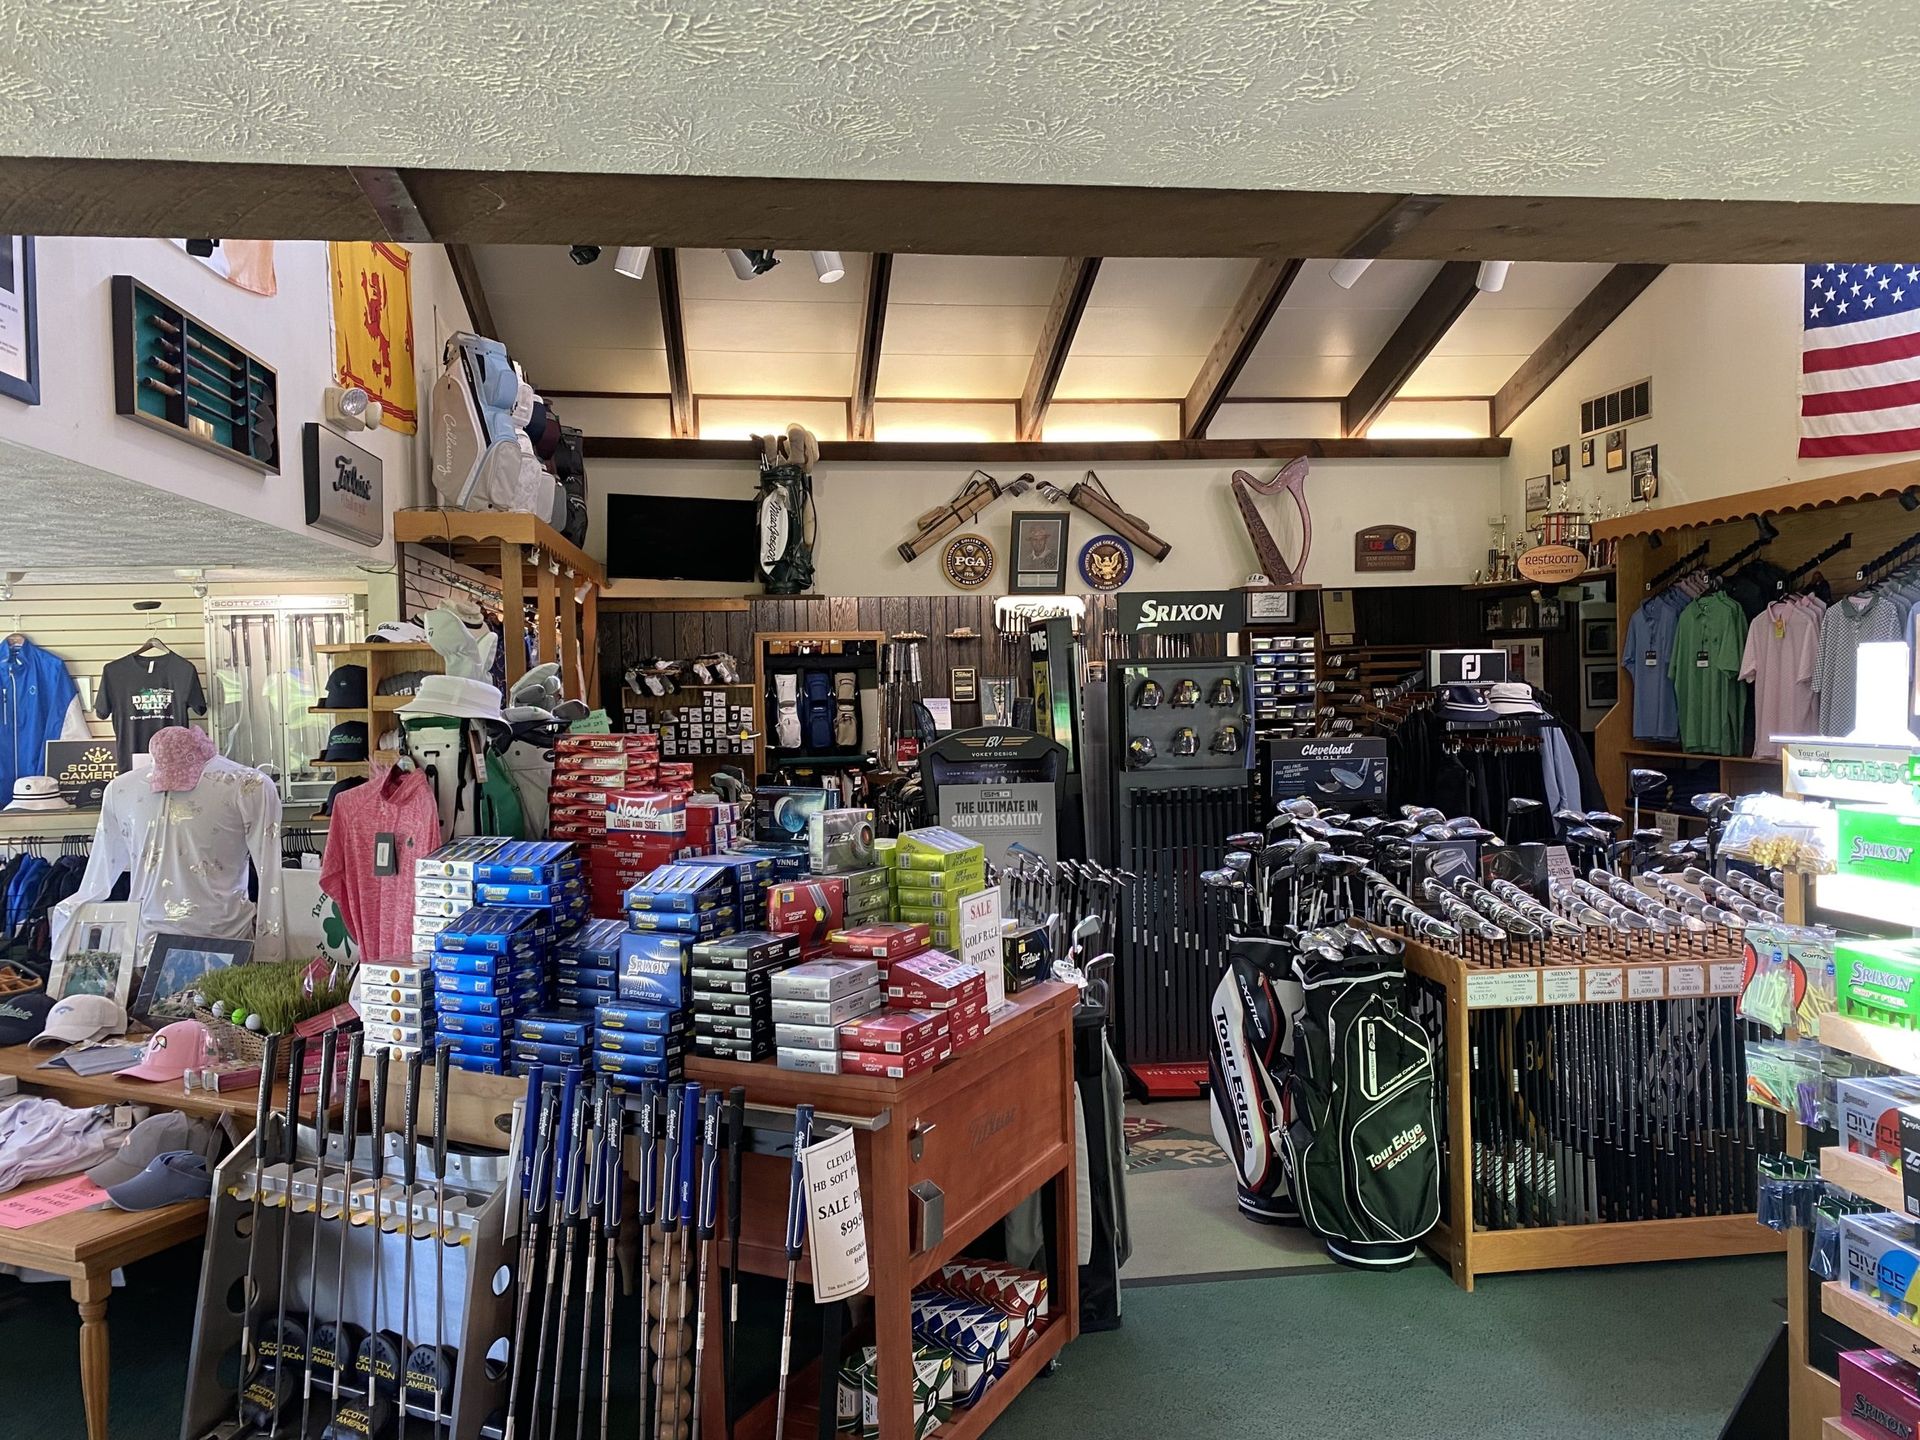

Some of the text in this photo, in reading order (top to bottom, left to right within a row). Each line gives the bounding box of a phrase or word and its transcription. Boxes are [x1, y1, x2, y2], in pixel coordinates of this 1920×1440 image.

[766, 500, 782, 561] MacGregor
[954, 556, 986, 567] PGA
[962, 576, 984, 585] AMERICA
[214, 600, 250, 608] SCOTTY
[1137, 599, 1224, 627] SRIXON
[1461, 654, 1481, 680] FJ
[131, 695, 172, 704] DEATH
[1301, 743, 1354, 756] Cleveland
[1798, 749, 1814, 757] Your
[60, 771, 119, 781] CAMERO
[67, 763, 117, 772] SCOTT
[587, 809, 606, 818] NACLE
[615, 799, 659, 819] Noodle
[955, 799, 1038, 814] THE ULTIMATE IN
[645, 821, 661, 830] SOFT
[952, 812, 1043, 828] SHOT VERSATILITY
[587, 827, 607, 835] NACLE
[1849, 836, 1912, 863] SRIXON
[776, 858, 799, 867] PINNA
[311, 892, 329, 919] Tam
[785, 910, 806, 918] CHROME
[971, 900, 992, 920] SALE
[965, 926, 998, 948] GOLF BALL
[628, 955, 670, 976] SRIXON
[970, 946, 995, 965] DOZENS
[1019, 952, 1041, 970] Titleist
[1849, 961, 1912, 992] SRIXON
[1238, 974, 1266, 1040] EXOTICS
[1213, 1005, 1253, 1150] Tour Edge
[1380, 1072, 1402, 1091] XTREME
[1402, 1063, 1416, 1076] CART
[1366, 1123, 1424, 1169] Tour Edge
[1387, 1135, 1428, 1170] EXOTICS
[826, 1149, 855, 1170] CLEVEL
[813, 1181, 827, 1193] HB
[830, 1170, 849, 1186] SOFT
[818, 1195, 850, 1220] SALE
[840, 1213, 863, 1237] $99.9
[845, 1242, 864, 1257] ORIGIN
[1849, 1248, 1905, 1292] DIVIDE
[258, 1348, 305, 1361] CAMRON
[311, 1346, 335, 1360] SCOTT
[1851, 1392, 1911, 1440] SRIXON
